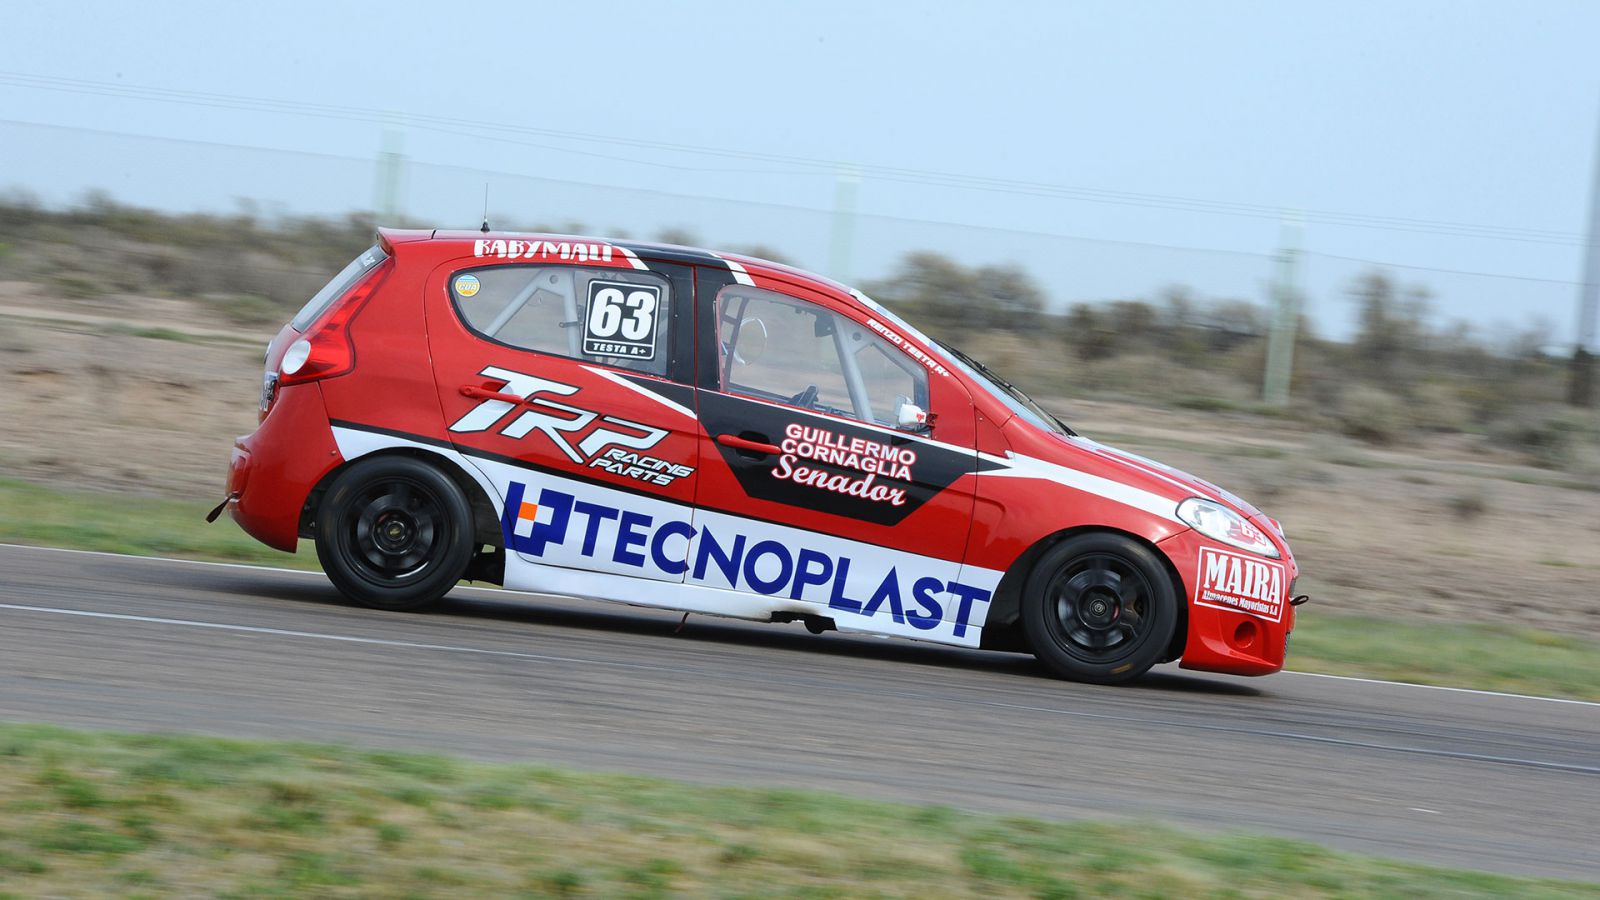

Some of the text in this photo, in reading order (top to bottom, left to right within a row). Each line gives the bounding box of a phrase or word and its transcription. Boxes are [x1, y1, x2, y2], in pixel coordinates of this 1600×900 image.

[591, 288, 655, 340] 63
[592, 342, 647, 357] TESTA A+
[902, 343, 935, 370] TESTA
[449, 365, 671, 464] TRP
[604, 447, 696, 478] RACING
[780, 438, 913, 482] CORNAGLIA
[785, 423, 917, 466] GUILLERMO
[589, 458, 676, 487] PARTS
[771, 455, 906, 507] Senador
[1241, 525, 1266, 546] 63
[574, 500, 991, 639] TECNOPLAST
[1203, 552, 1280, 605] MAIRA
[1202, 590, 1239, 606] Almacenes
